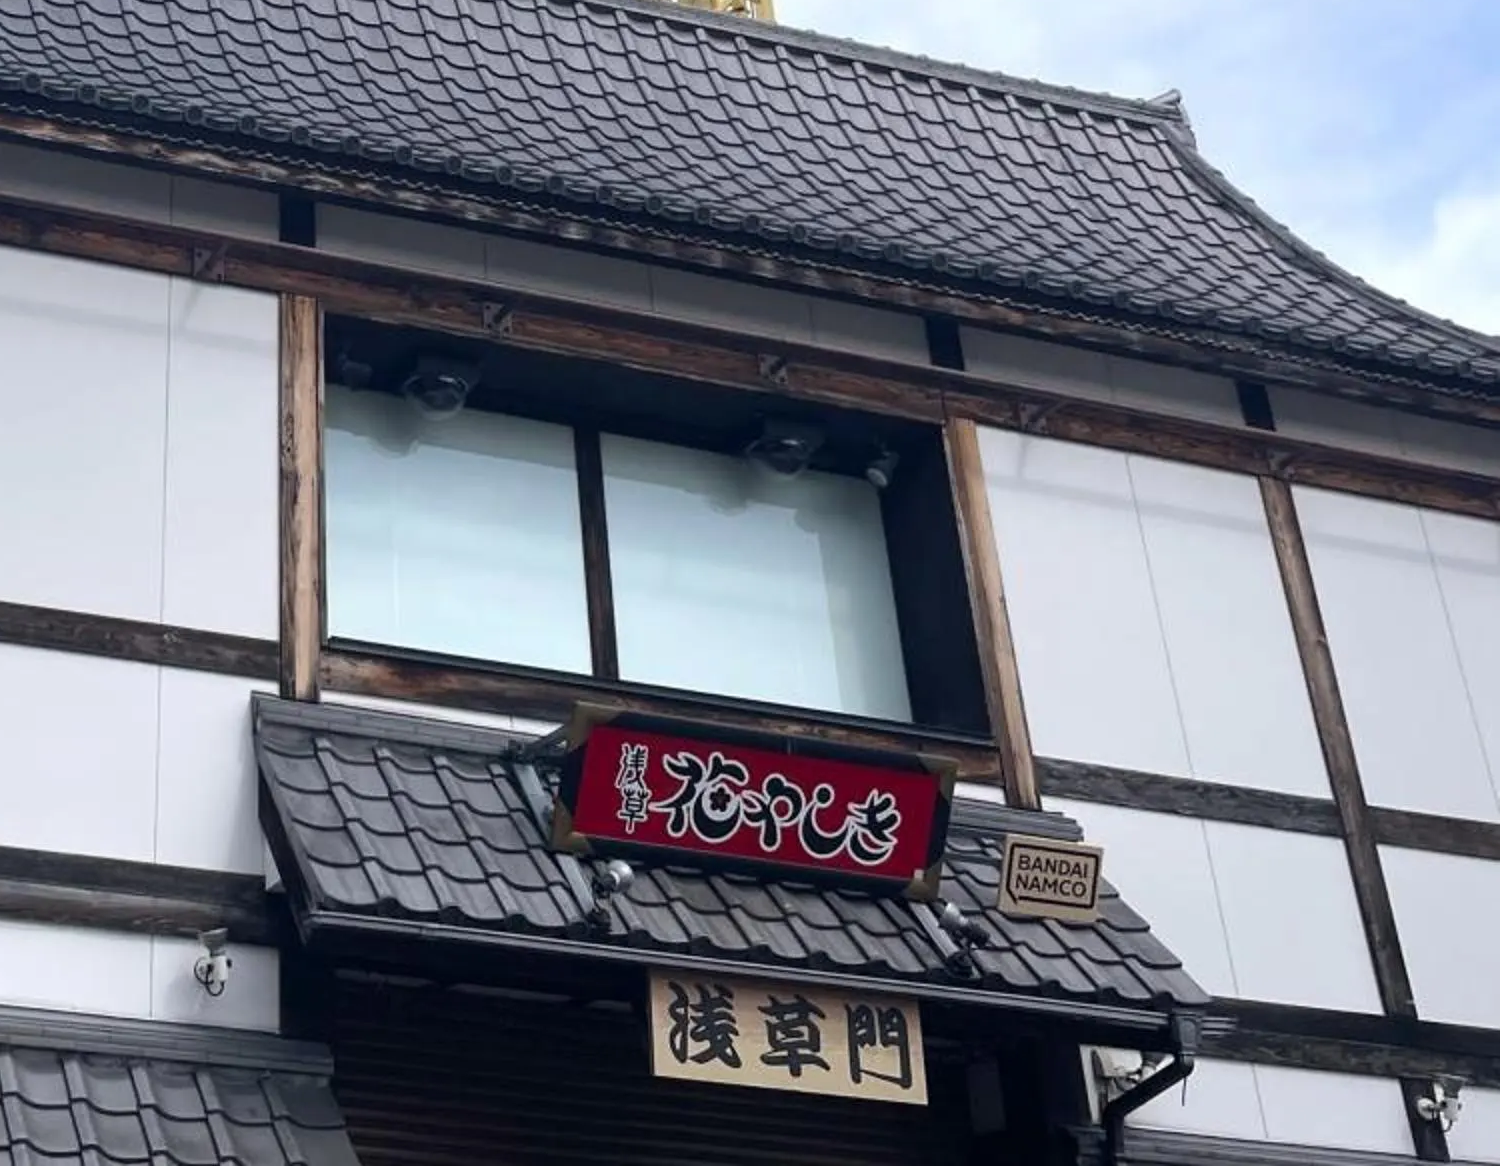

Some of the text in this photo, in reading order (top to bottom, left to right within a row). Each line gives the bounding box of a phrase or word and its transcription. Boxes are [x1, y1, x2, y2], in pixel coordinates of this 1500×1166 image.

[614, 742, 652, 834] 浅草
[649, 751, 902, 865] 花やしき
[1016, 873, 1087, 898] NAMCO
[1018, 854, 1089, 879] BANDAI
[667, 980, 913, 1090] 浅草門
